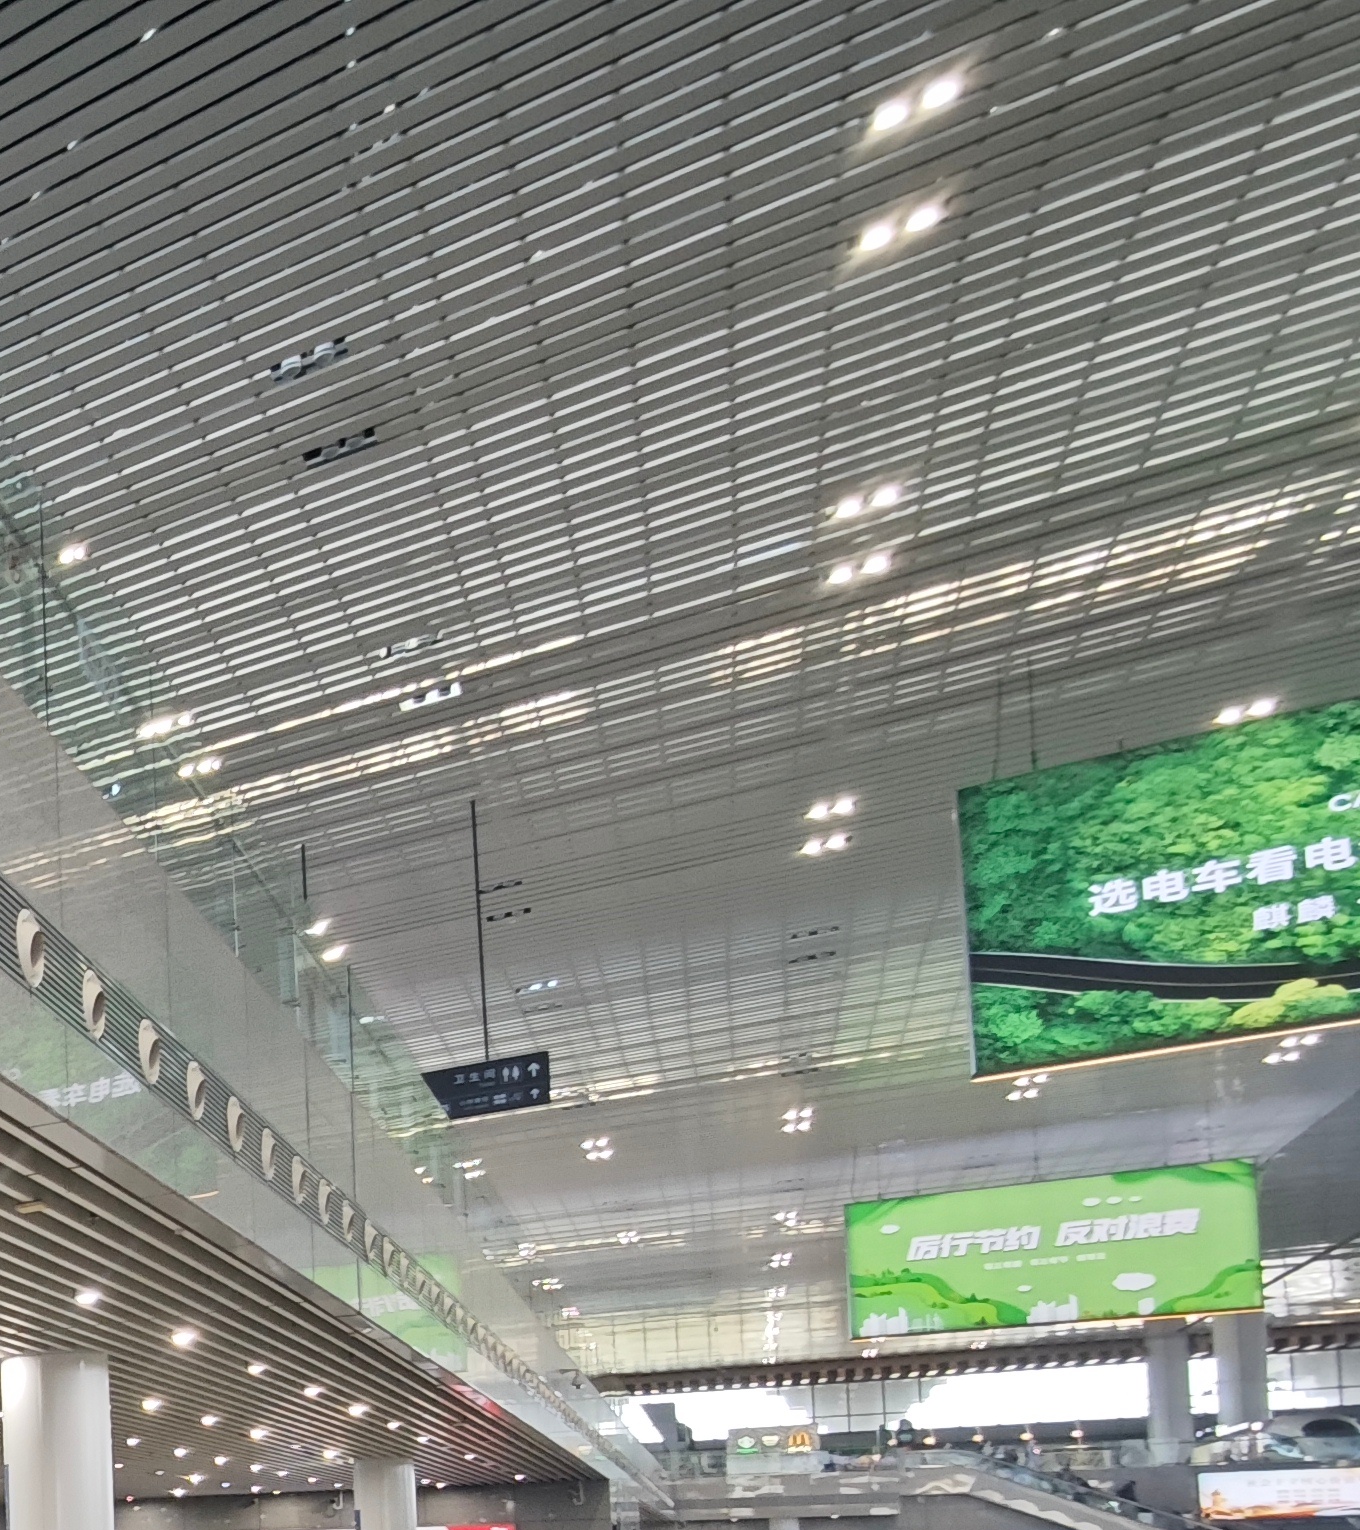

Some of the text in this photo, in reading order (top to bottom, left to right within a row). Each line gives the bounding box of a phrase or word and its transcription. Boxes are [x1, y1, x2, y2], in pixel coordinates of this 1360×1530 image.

[1087, 836, 1360, 917] 选电车看电
[906, 1224, 1041, 1262] 厉行节约
[1053, 1207, 1201, 1248] 反对浪费
